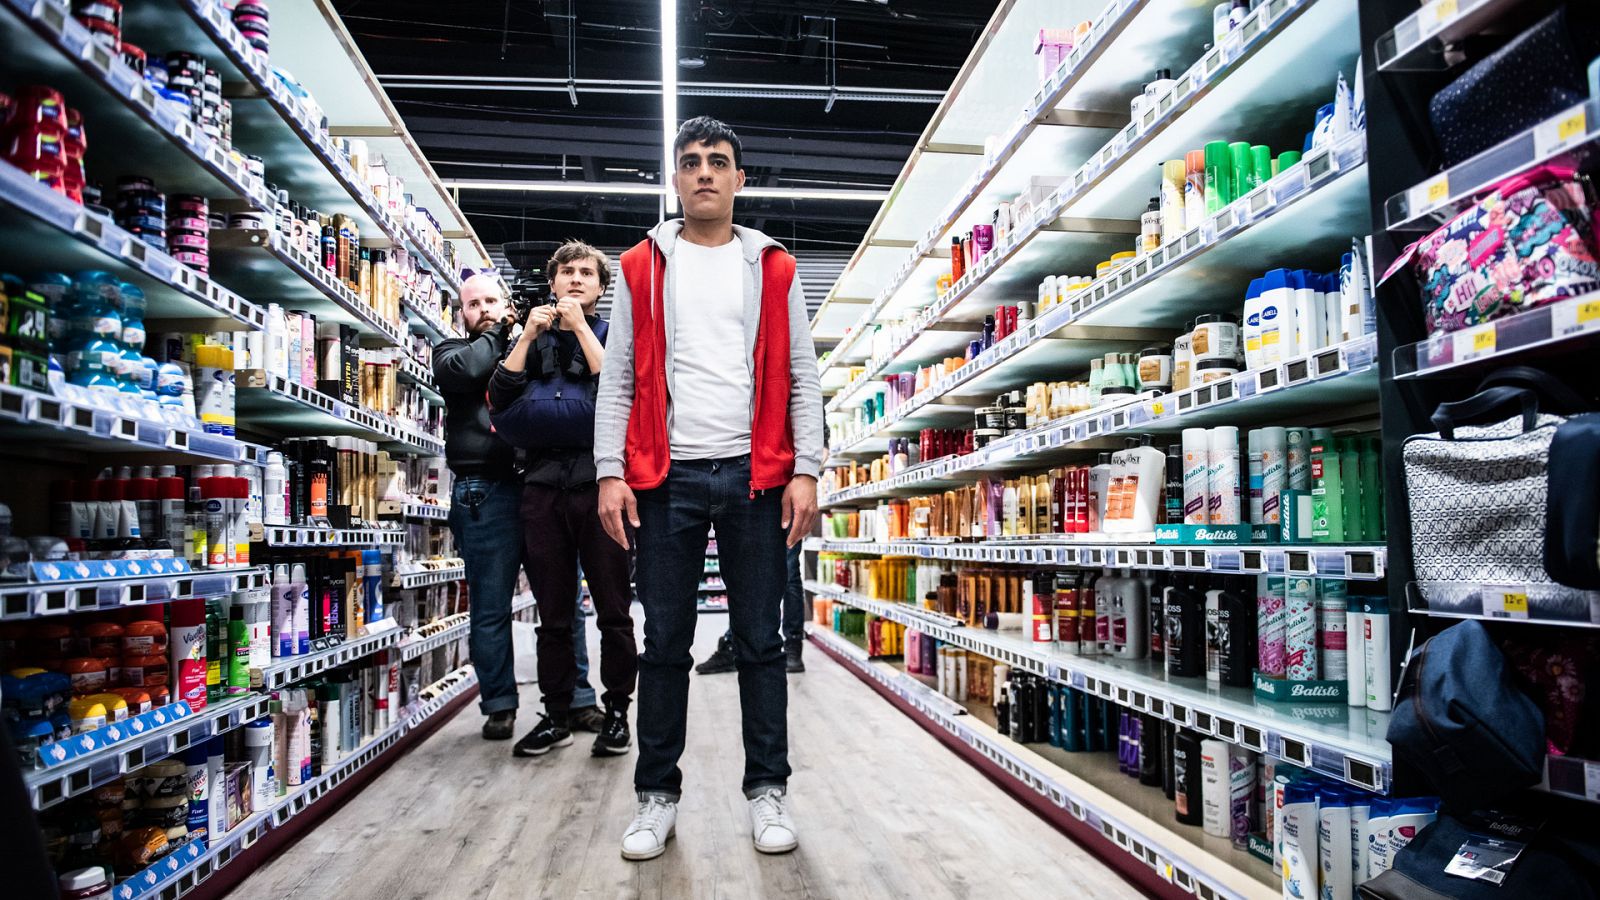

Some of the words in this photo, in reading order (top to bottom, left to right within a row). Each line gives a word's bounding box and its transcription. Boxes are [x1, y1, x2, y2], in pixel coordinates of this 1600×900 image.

[1455, 278, 1478, 305] Hi!
[1282, 494, 1290, 541] Batiste
[1194, 528, 1238, 541] Batiste
[1291, 684, 1340, 697] Batiste
